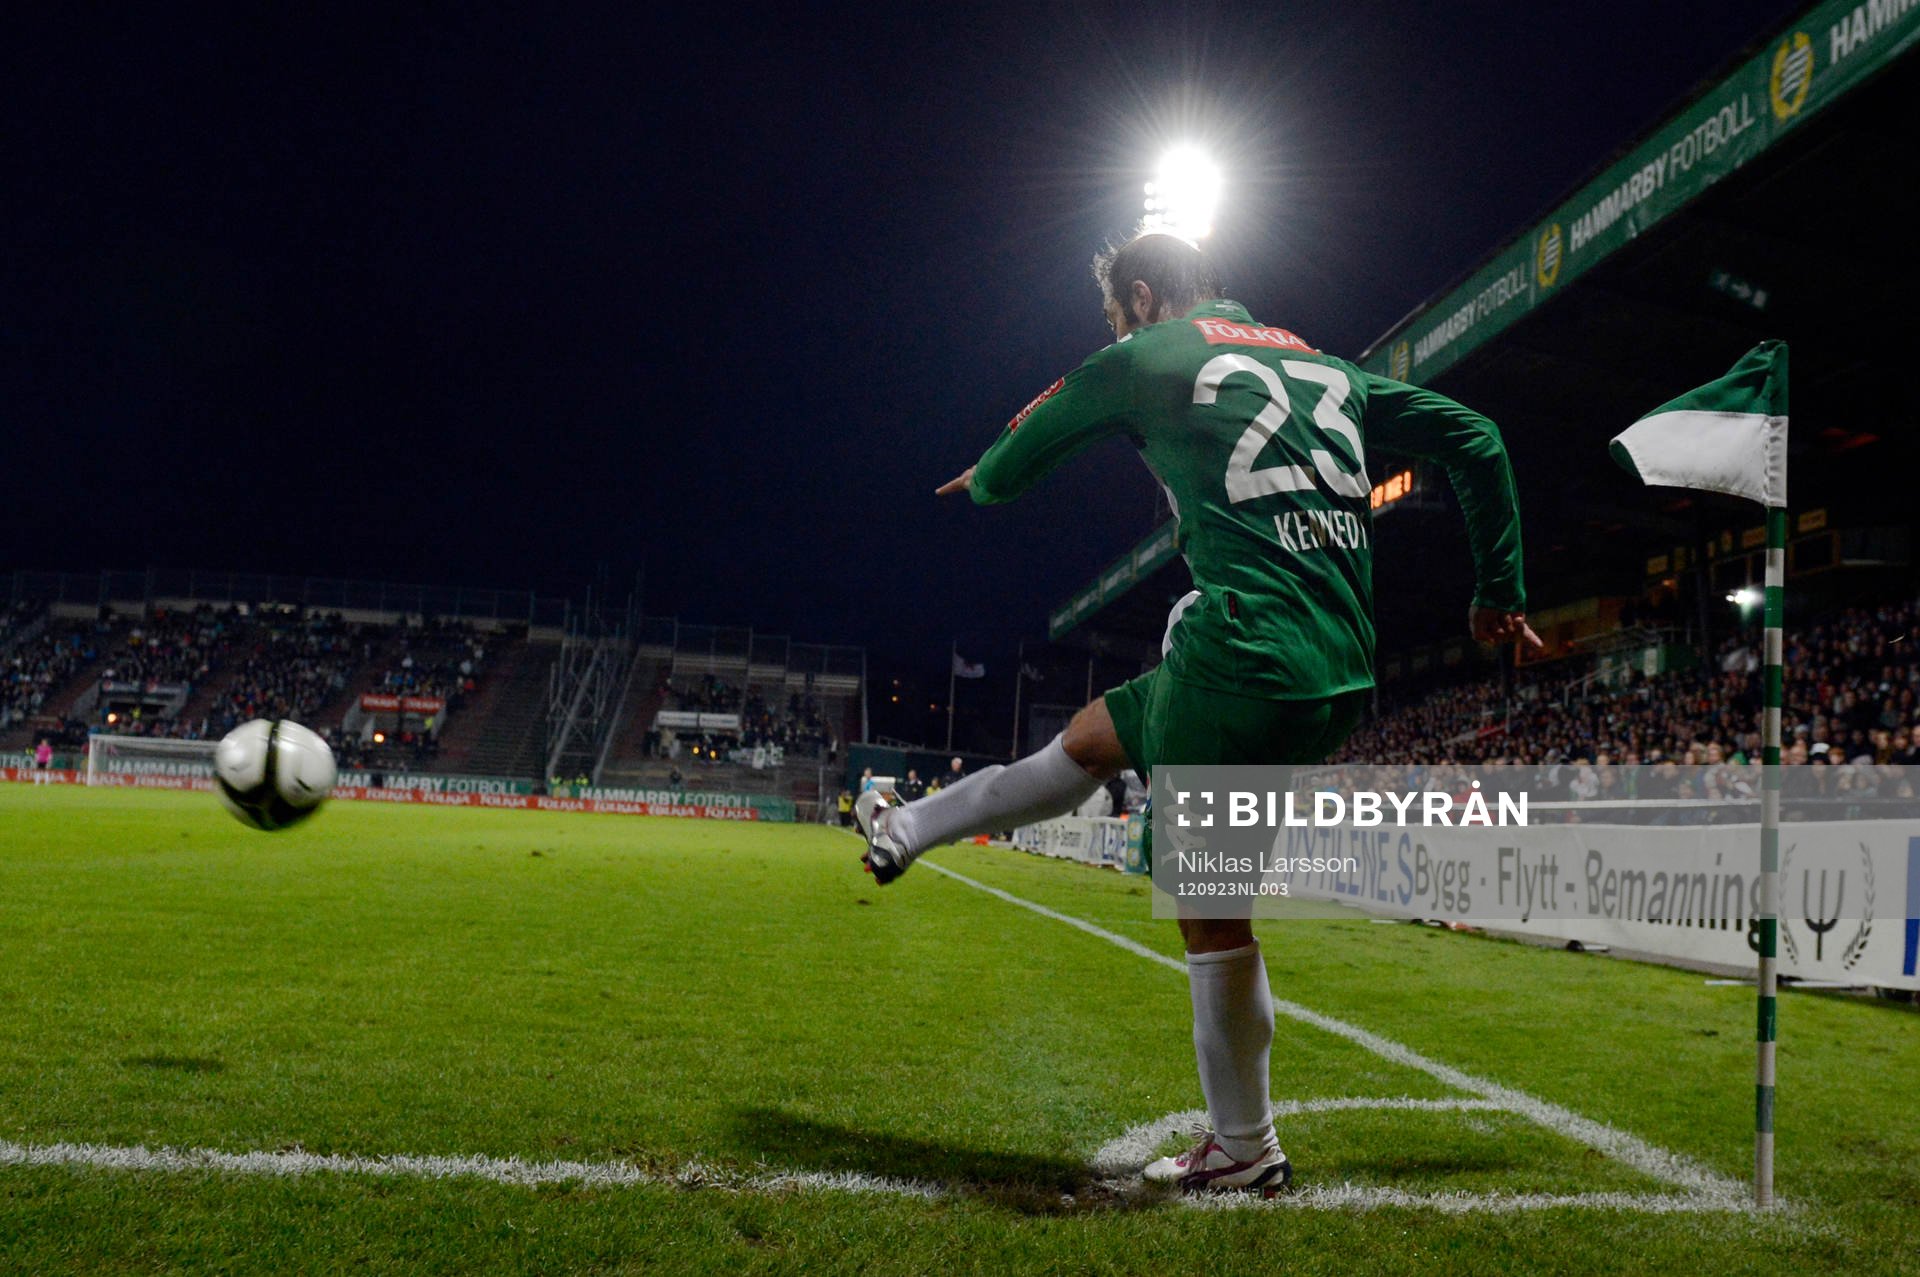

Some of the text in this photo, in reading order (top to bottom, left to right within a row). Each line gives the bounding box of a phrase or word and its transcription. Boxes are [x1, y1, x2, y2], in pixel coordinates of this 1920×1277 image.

[1570, 94, 1755, 252] HAMMARBY FOTBOLL
[1193, 353, 1372, 504] 23
[447, 778, 519, 796] FOTBOLL
[579, 787, 682, 806] HAMMARBY
[1415, 843, 1471, 914] Bygg
[1498, 846, 1559, 923] Flytt
